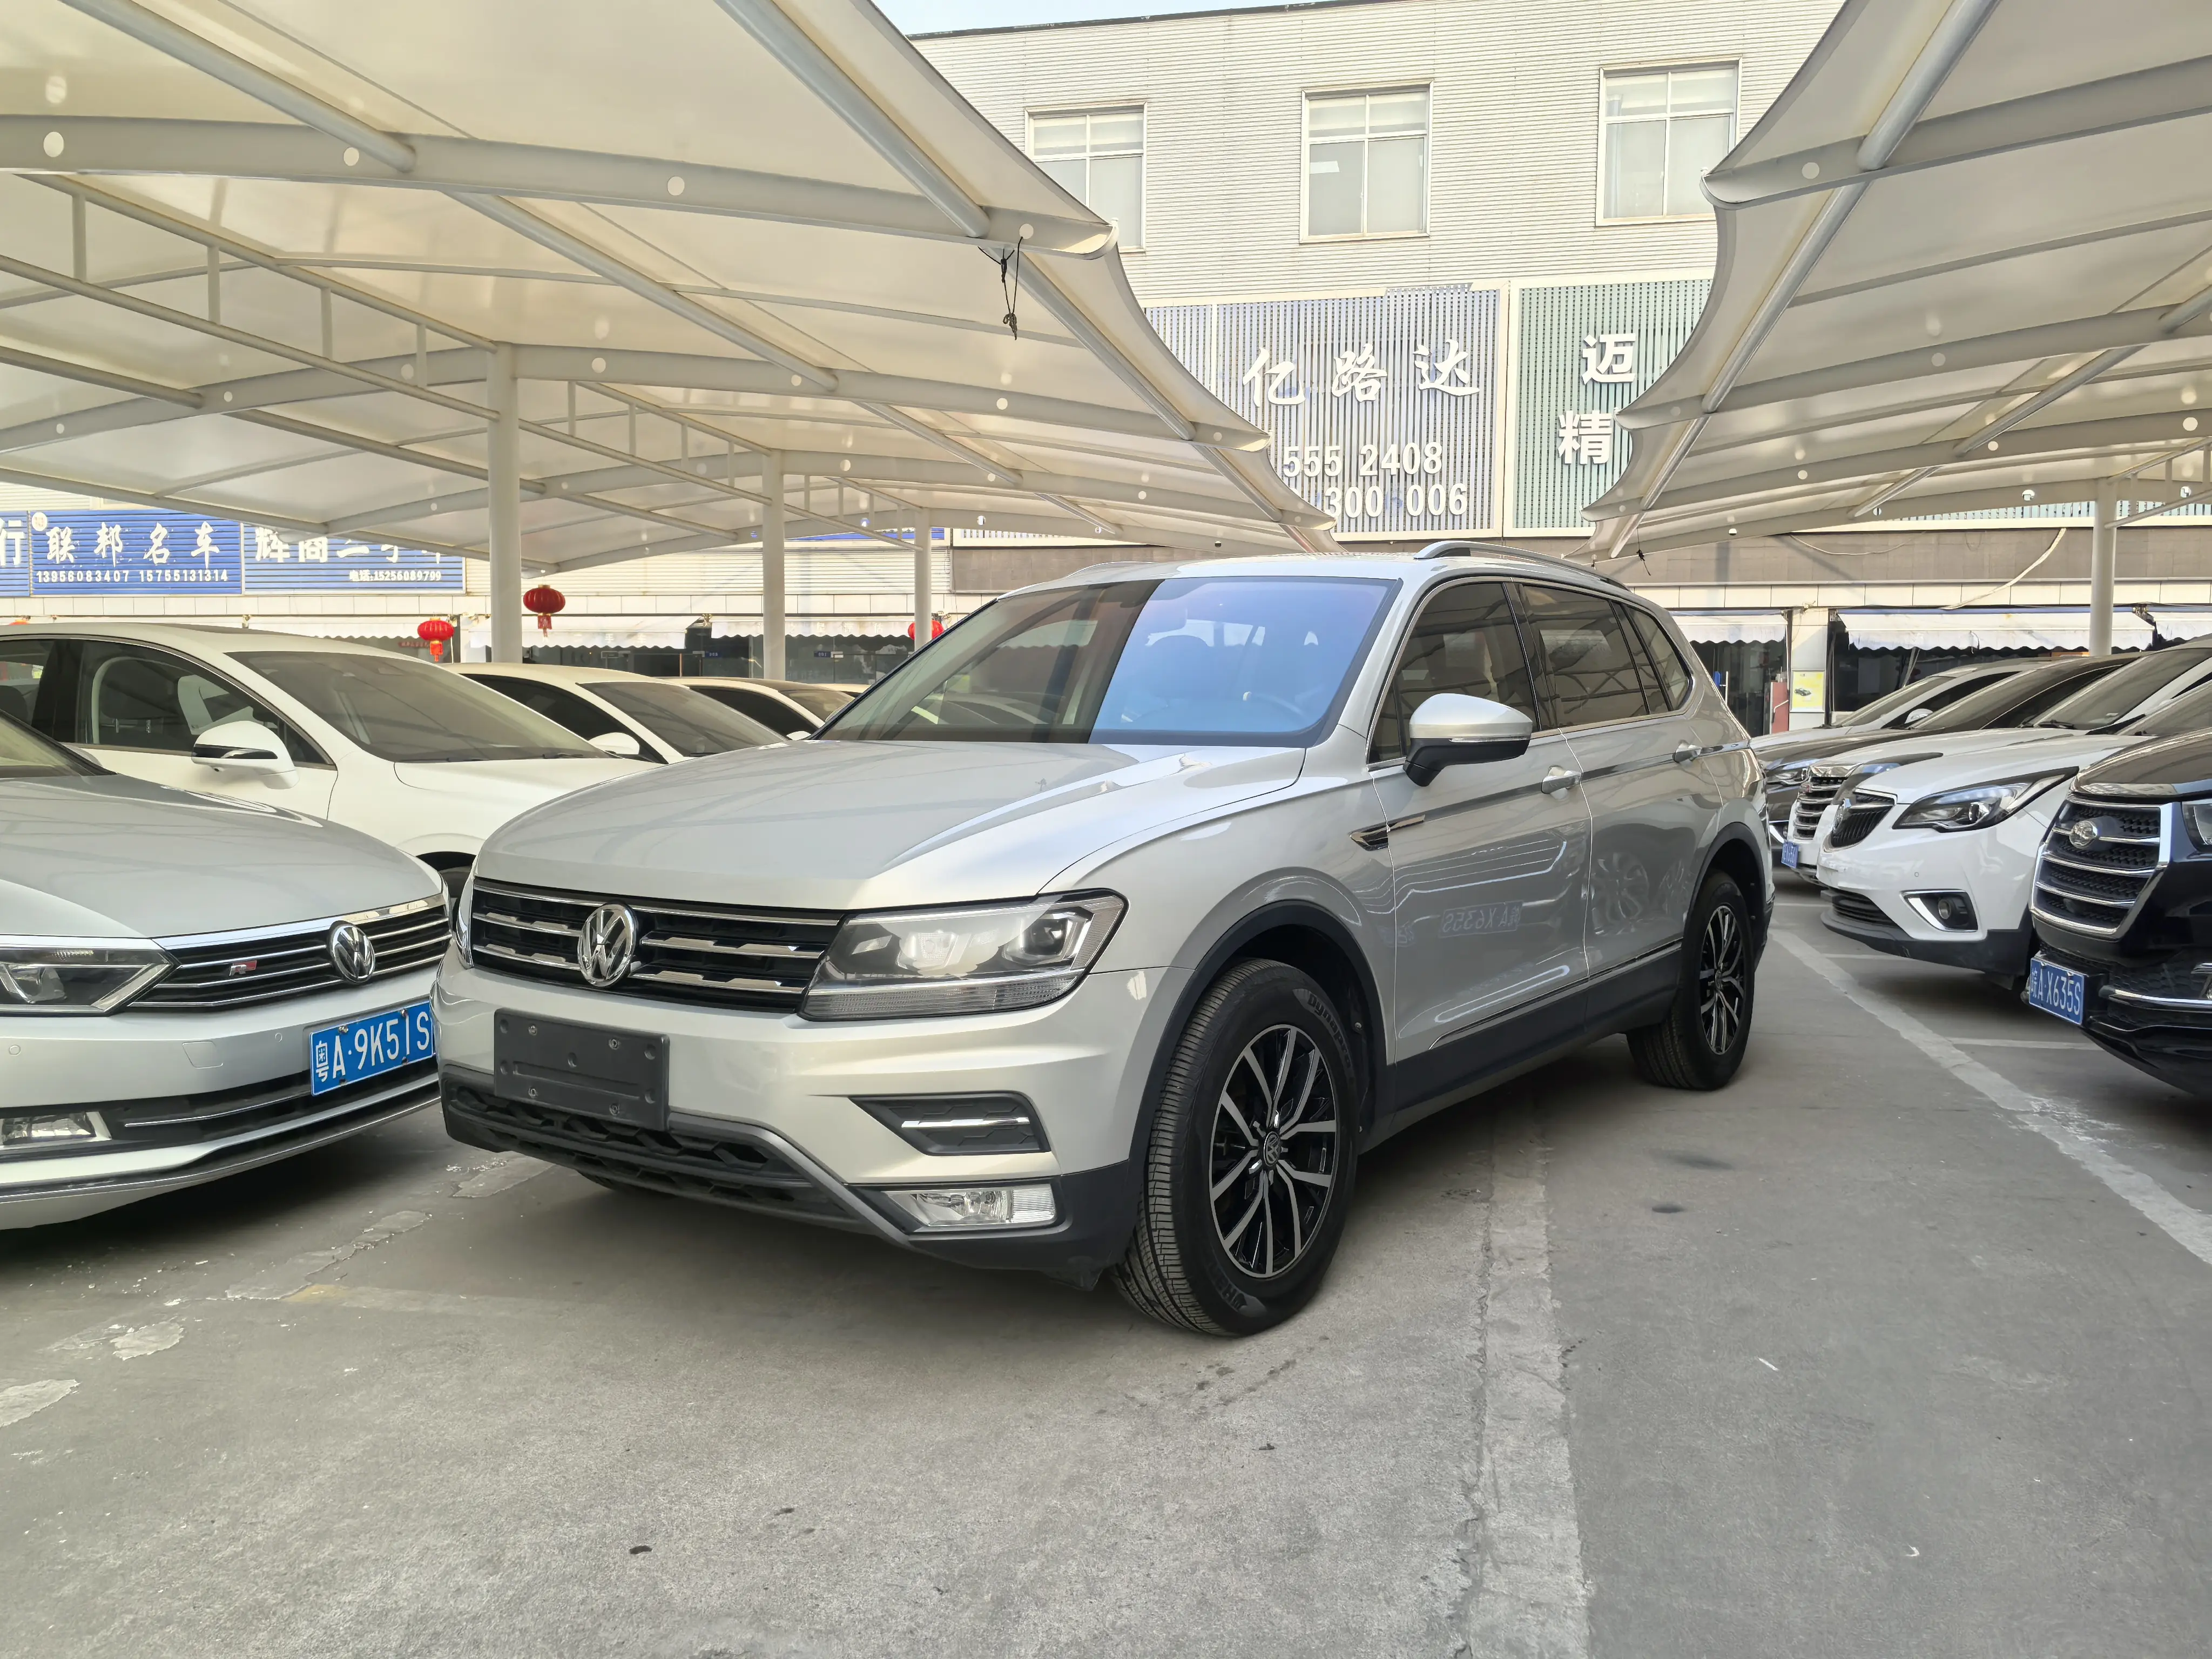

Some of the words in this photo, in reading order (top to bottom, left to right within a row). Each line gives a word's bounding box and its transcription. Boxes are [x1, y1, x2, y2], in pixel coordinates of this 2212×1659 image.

[1243, 339, 1480, 407] 亿路达
[1581, 333, 1636, 385] 迈
[1283, 444, 1343, 477] 555
[1359, 442, 1443, 476] 2408
[1557, 410, 1613, 465] 精
[1406, 483, 1468, 517] 006
[47, 521, 220, 569] 联邦名车
[36, 570, 129, 583] 13956083407
[139, 569, 228, 582] 15755131314
